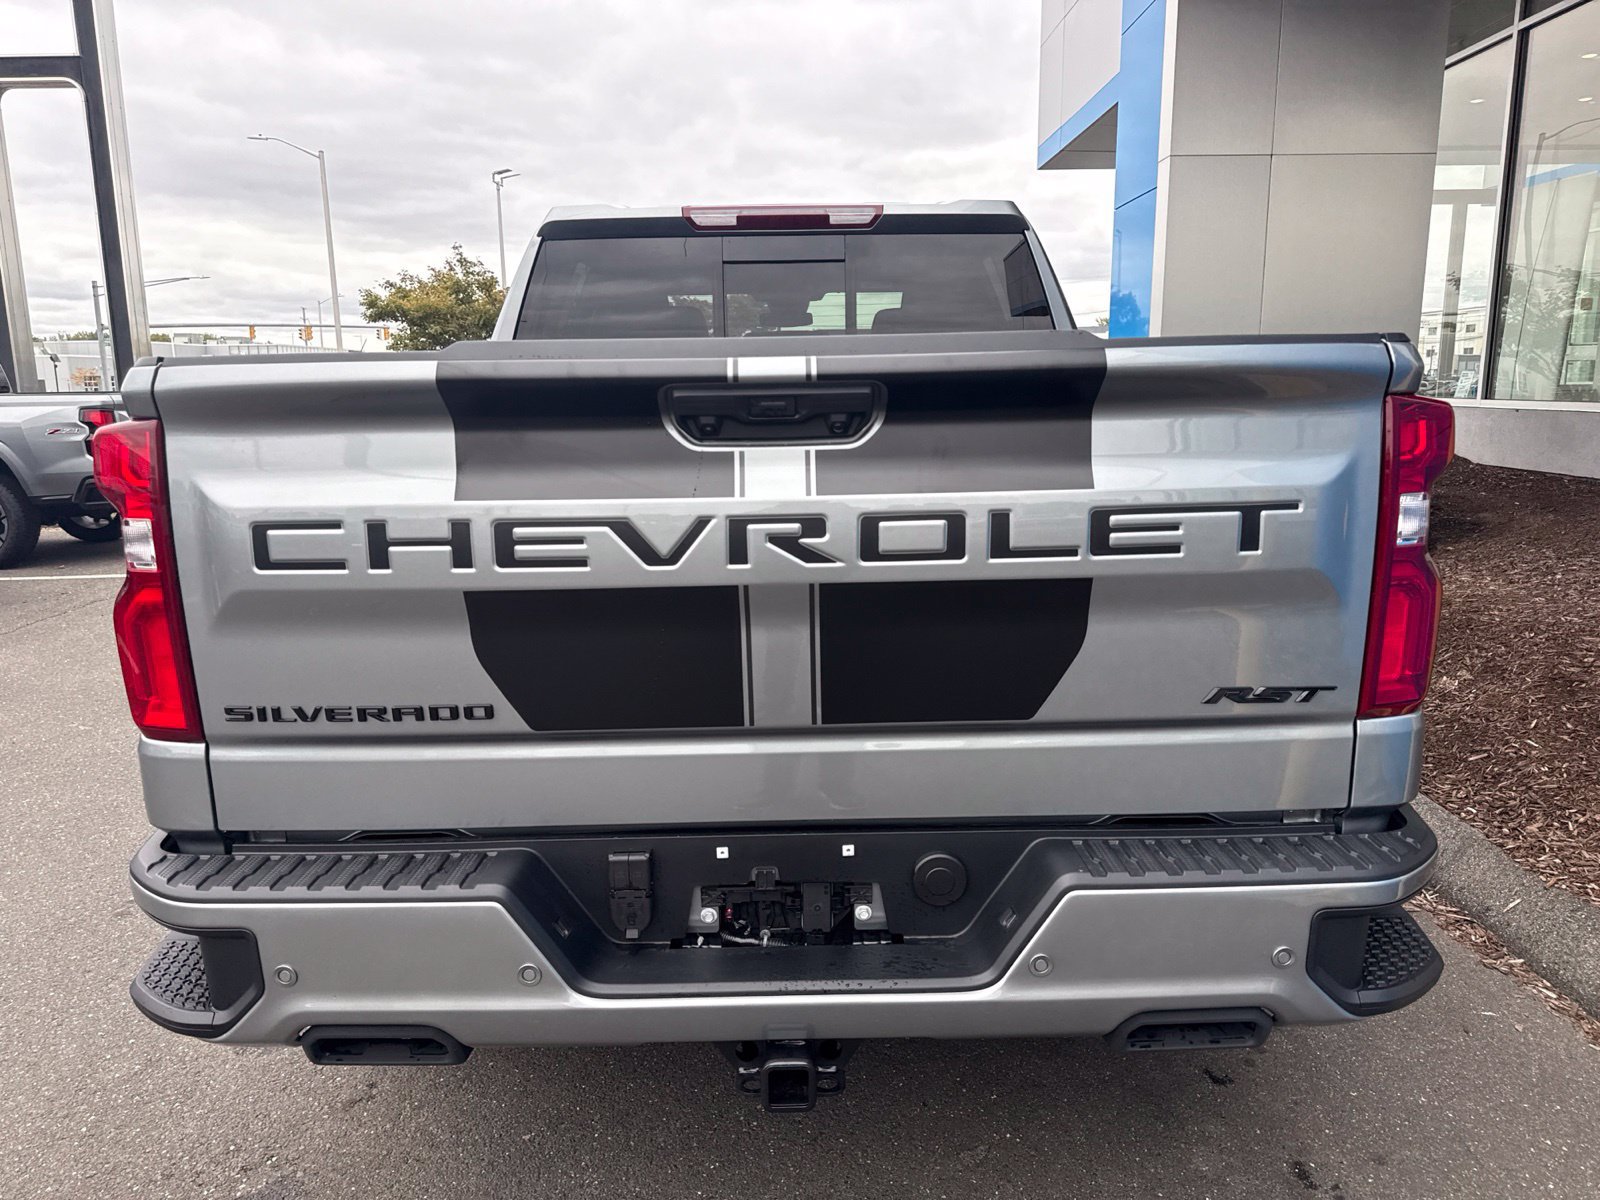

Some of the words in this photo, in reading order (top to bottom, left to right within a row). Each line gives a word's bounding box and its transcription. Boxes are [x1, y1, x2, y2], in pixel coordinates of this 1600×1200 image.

[250, 500, 1303, 575] CHEVROLET
[1200, 685, 1338, 704] RST
[223, 703, 494, 723] SILVERADO
